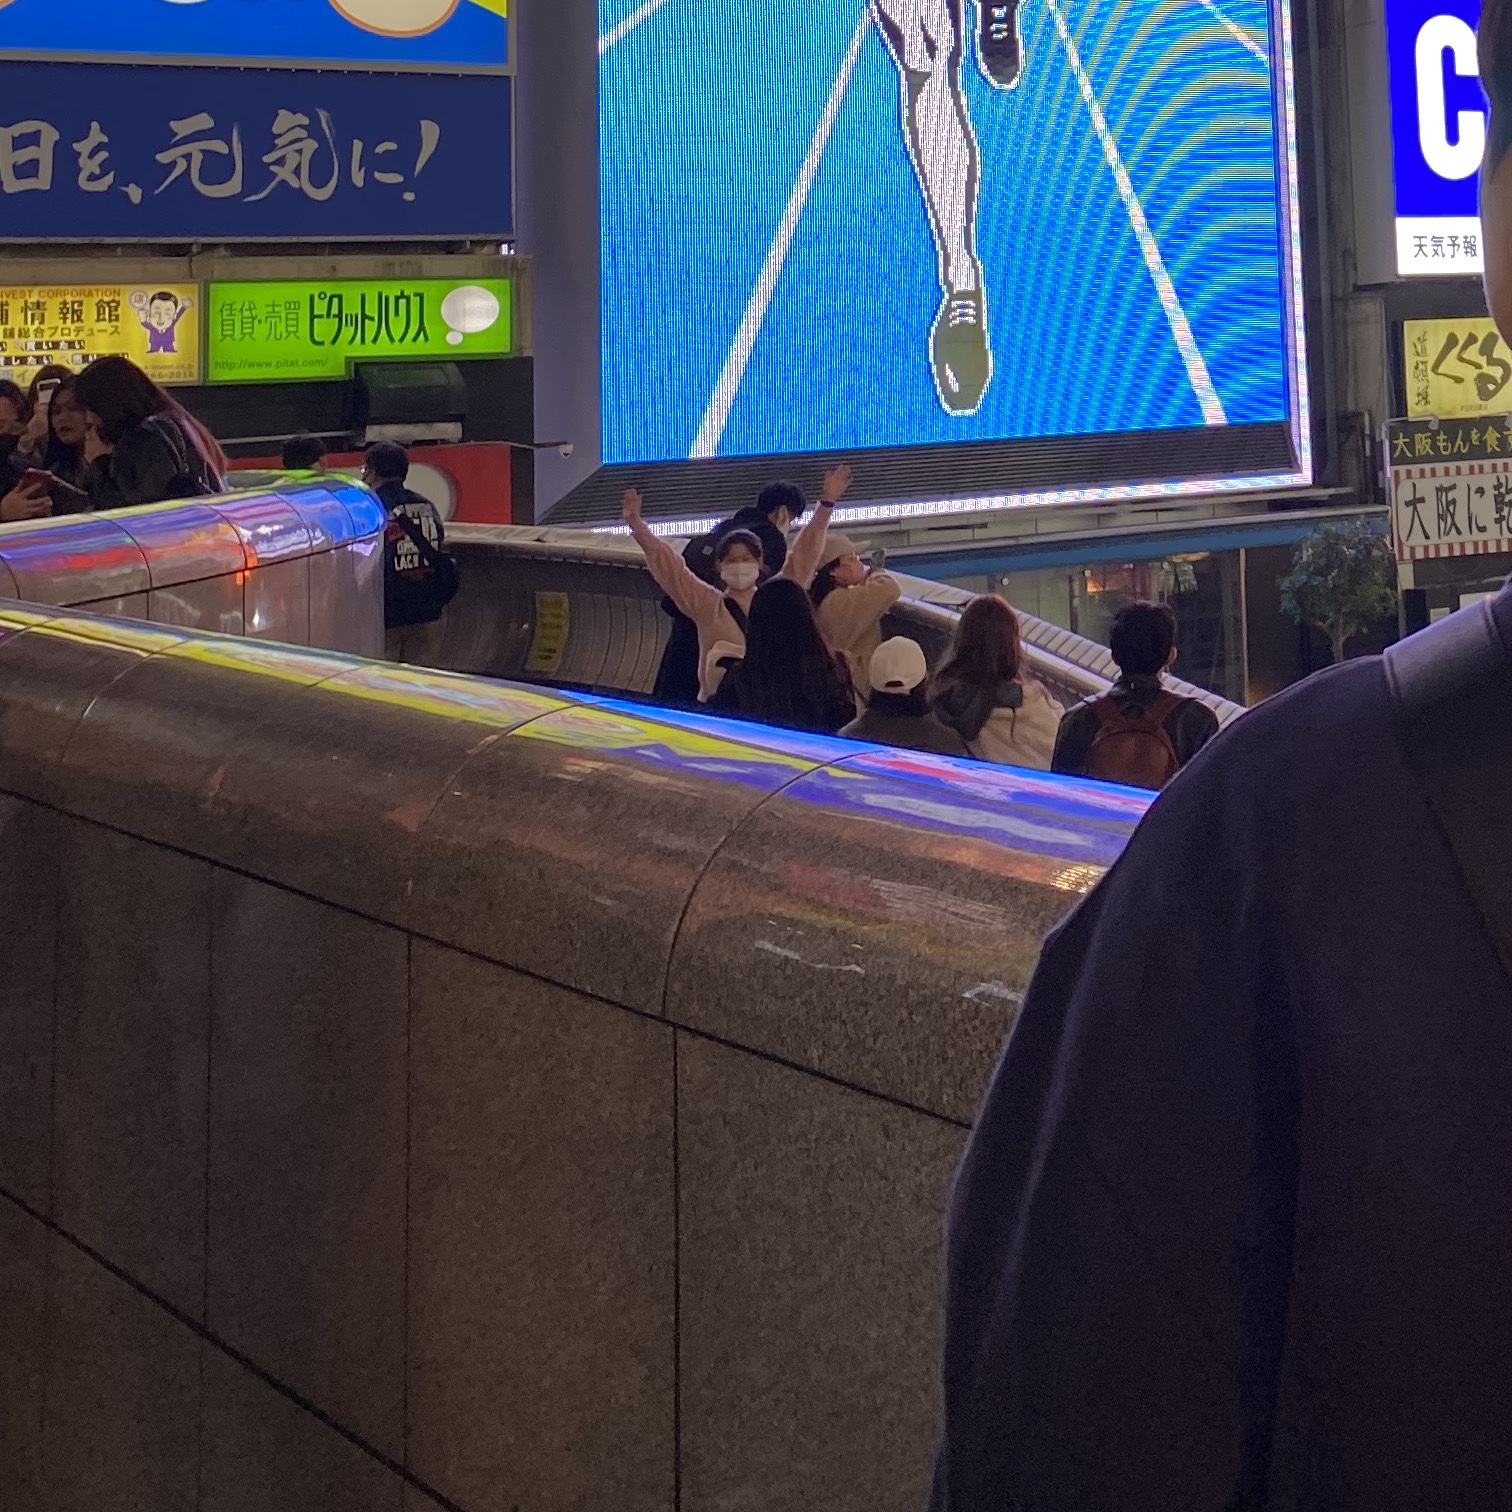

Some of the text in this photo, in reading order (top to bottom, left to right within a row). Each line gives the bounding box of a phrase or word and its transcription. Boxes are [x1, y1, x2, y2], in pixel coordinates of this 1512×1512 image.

[1413, 233, 1479, 260] 天気予報
[42, 287, 121, 299] CORPORATION
[219, 289, 430, 346] 賃貸・売買 ピタットハウス
[214, 357, 328, 371] http://www.pitat.com/
